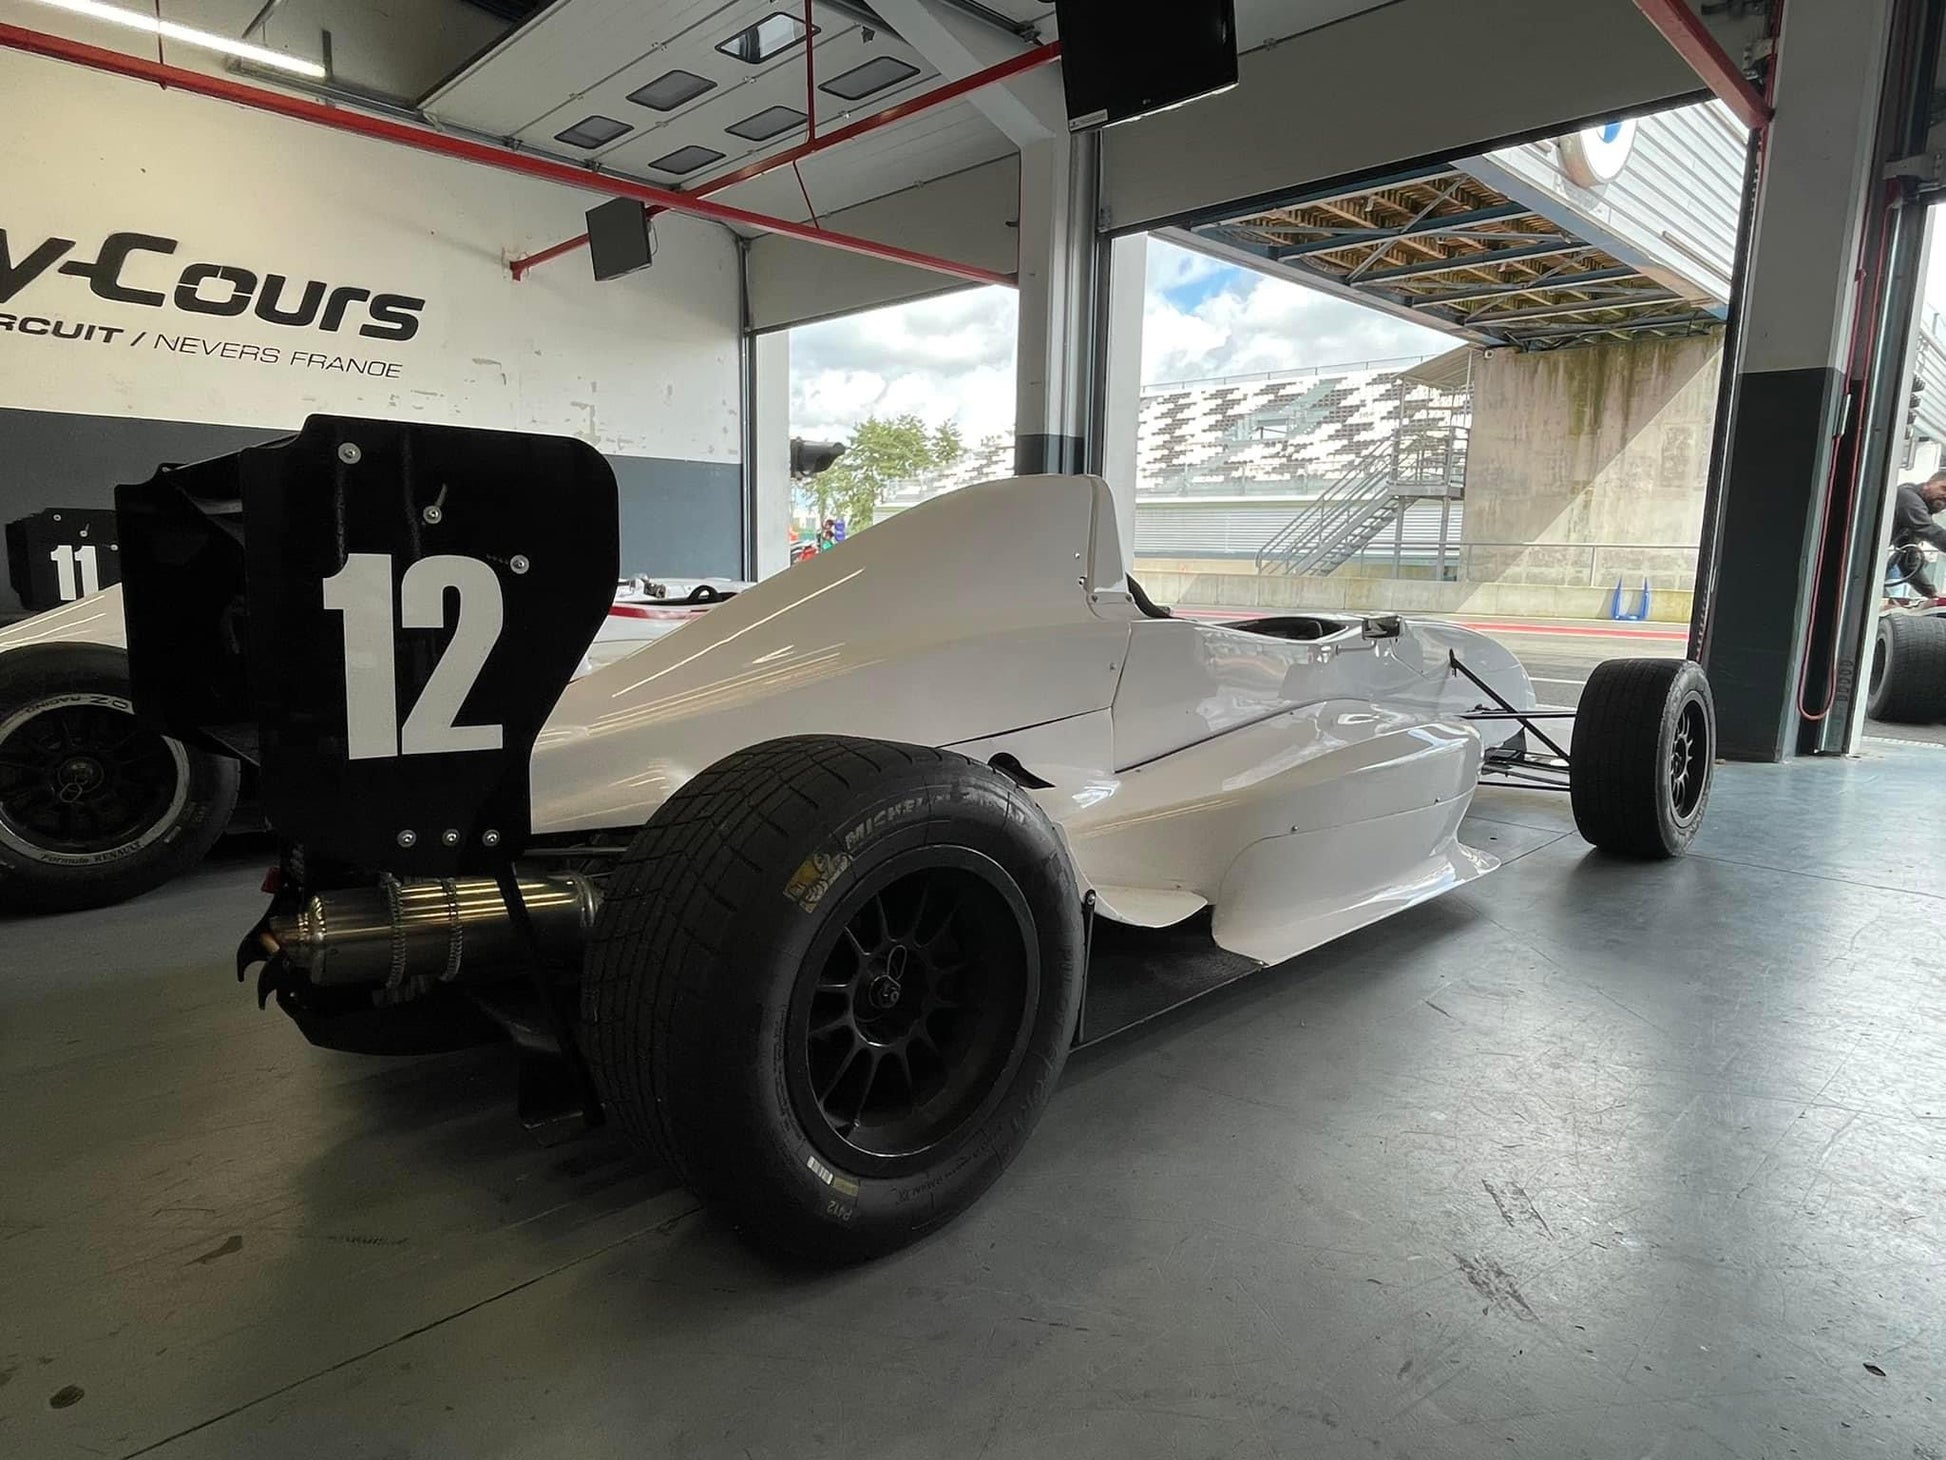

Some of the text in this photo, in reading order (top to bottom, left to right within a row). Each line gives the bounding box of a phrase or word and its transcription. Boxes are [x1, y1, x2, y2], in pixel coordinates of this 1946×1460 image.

[154, 333, 280, 363] NEVERS
[50, 544, 99, 601] 11
[322, 553, 504, 760] 12
